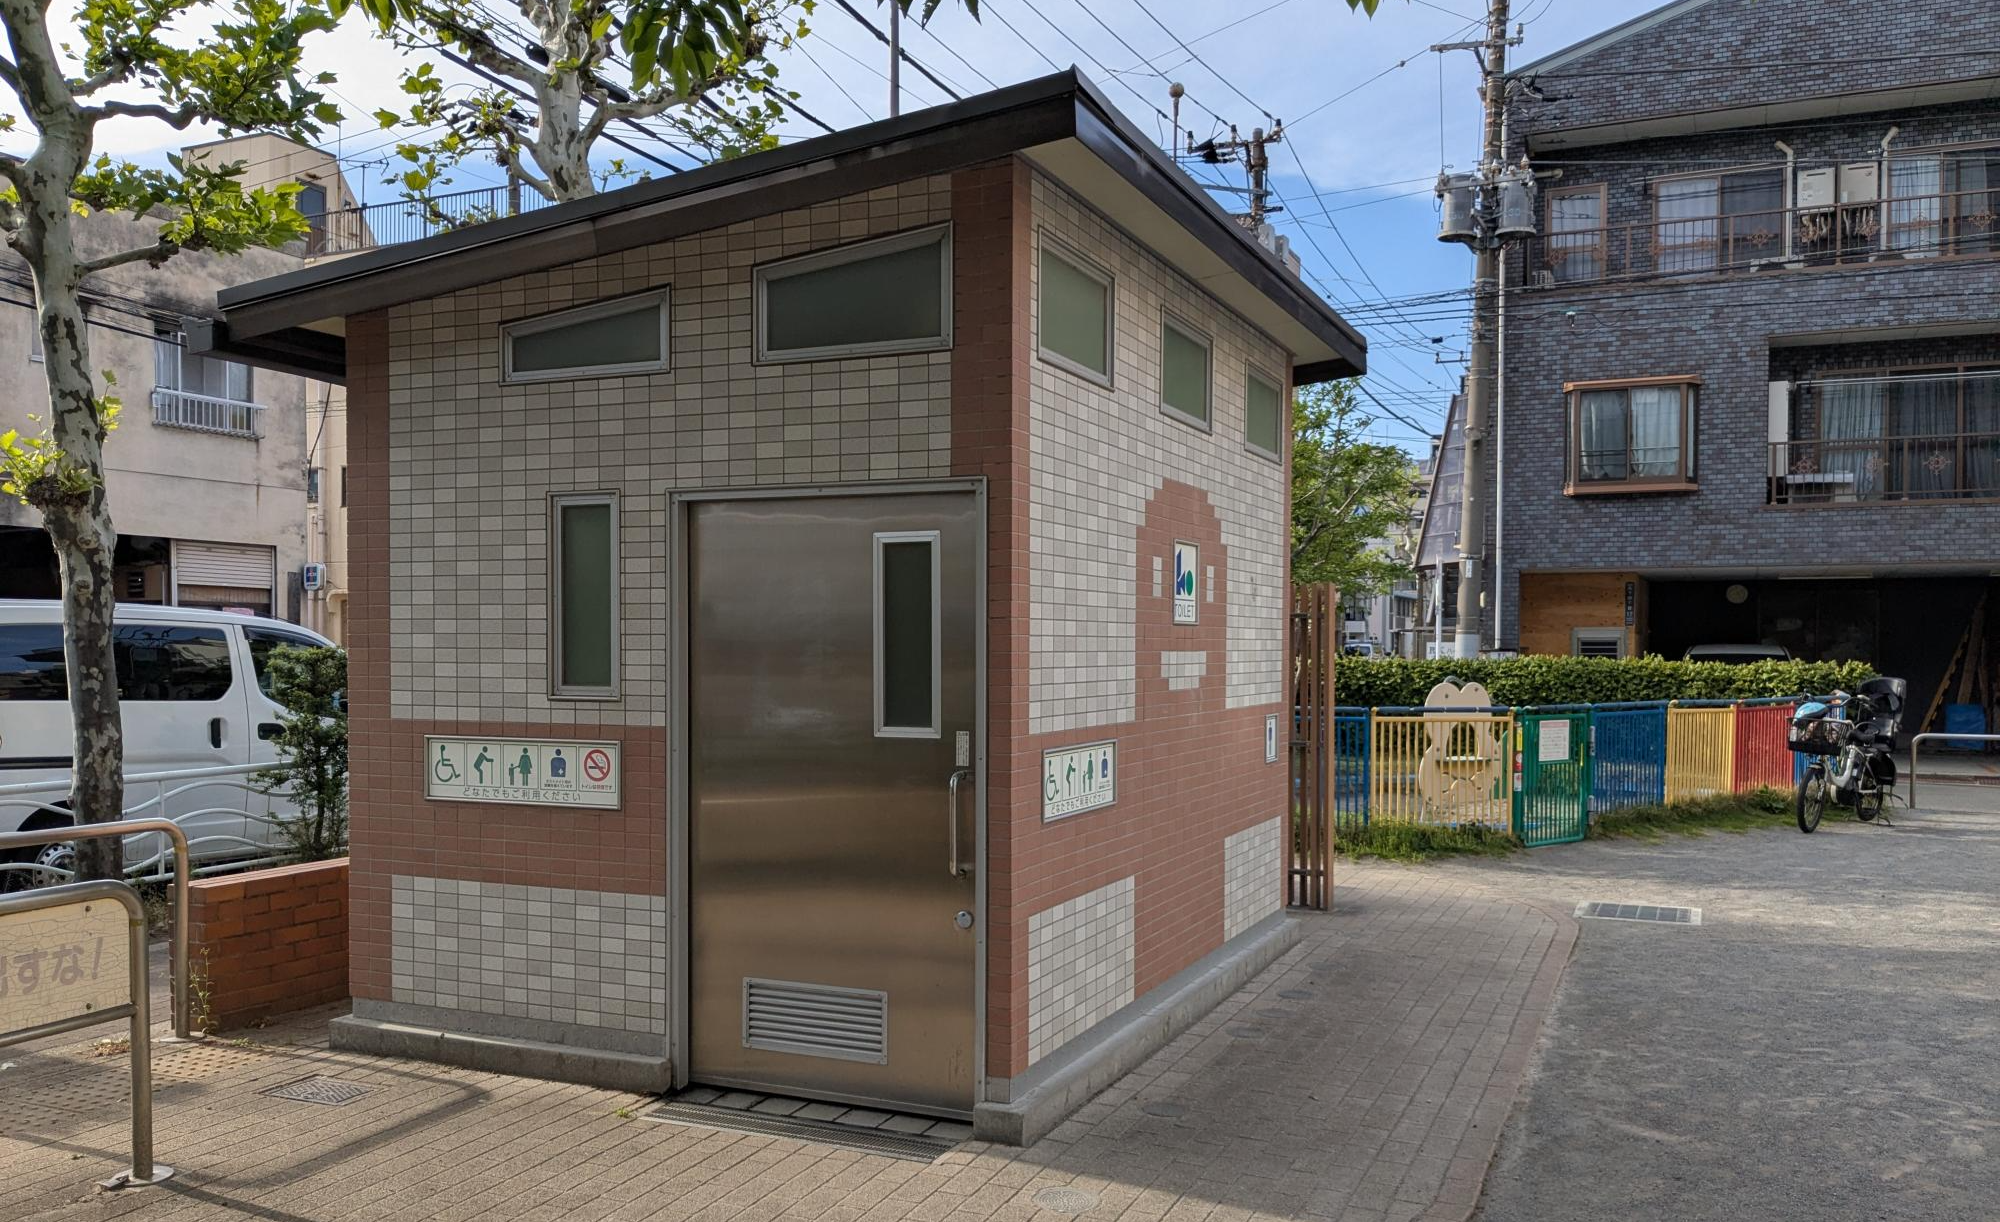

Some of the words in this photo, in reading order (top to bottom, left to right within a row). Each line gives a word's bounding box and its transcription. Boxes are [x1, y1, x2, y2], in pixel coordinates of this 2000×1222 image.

[1175, 603, 1194, 618] TOILET
[463, 787, 581, 801] どなたでもご利用ください
[0, 937, 104, 996] すな!
